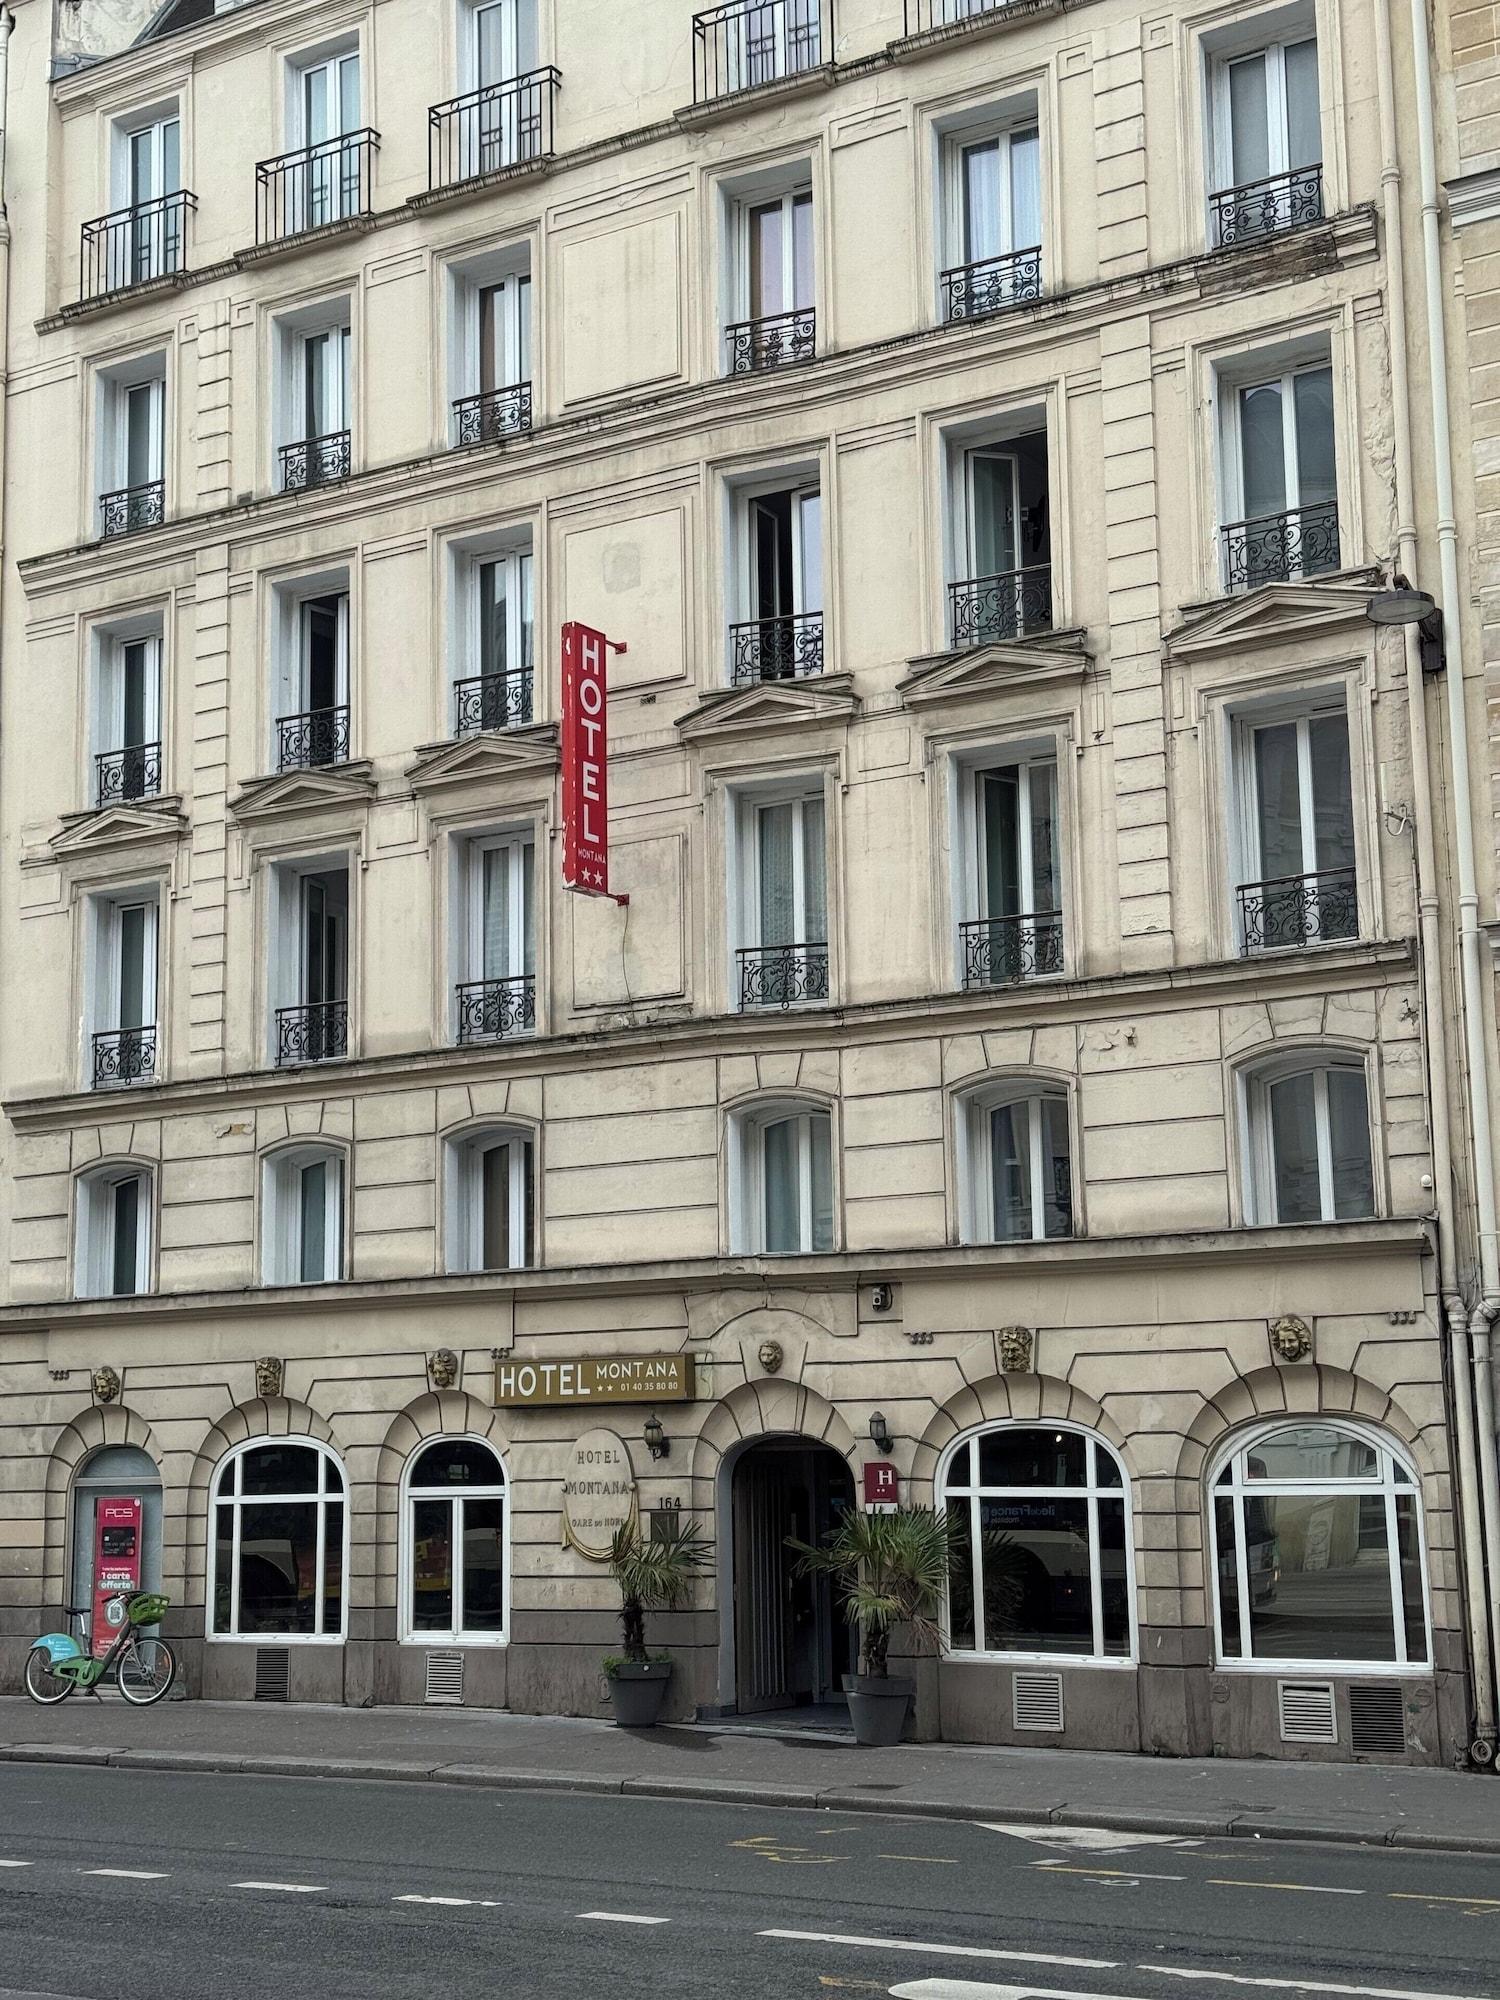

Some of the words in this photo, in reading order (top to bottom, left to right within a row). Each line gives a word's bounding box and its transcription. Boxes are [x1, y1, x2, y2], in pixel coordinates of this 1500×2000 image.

[579, 634, 602, 844] HOTEL
[577, 847, 606, 864] MONTANA
[500, 1363, 590, 1398] HOTEL
[596, 1361, 678, 1379] MONTANA
[620, 1382, 630, 1391] 01
[632, 1382, 642, 1391] 40
[644, 1382, 654, 1391] 35
[656, 1381, 666, 1390] 80
[668, 1381, 678, 1390] 80
[577, 1450, 620, 1464] HOTEL
[878, 1469, 893, 1485] H
[567, 1481, 629, 1496] MONTANA
[659, 1496, 682, 1509] 164
[105, 1507, 133, 1518] PCS
[101, 1571, 106, 1580] 1
[107, 1571, 131, 1580] carte
[101, 1580, 131, 1589] offerte
